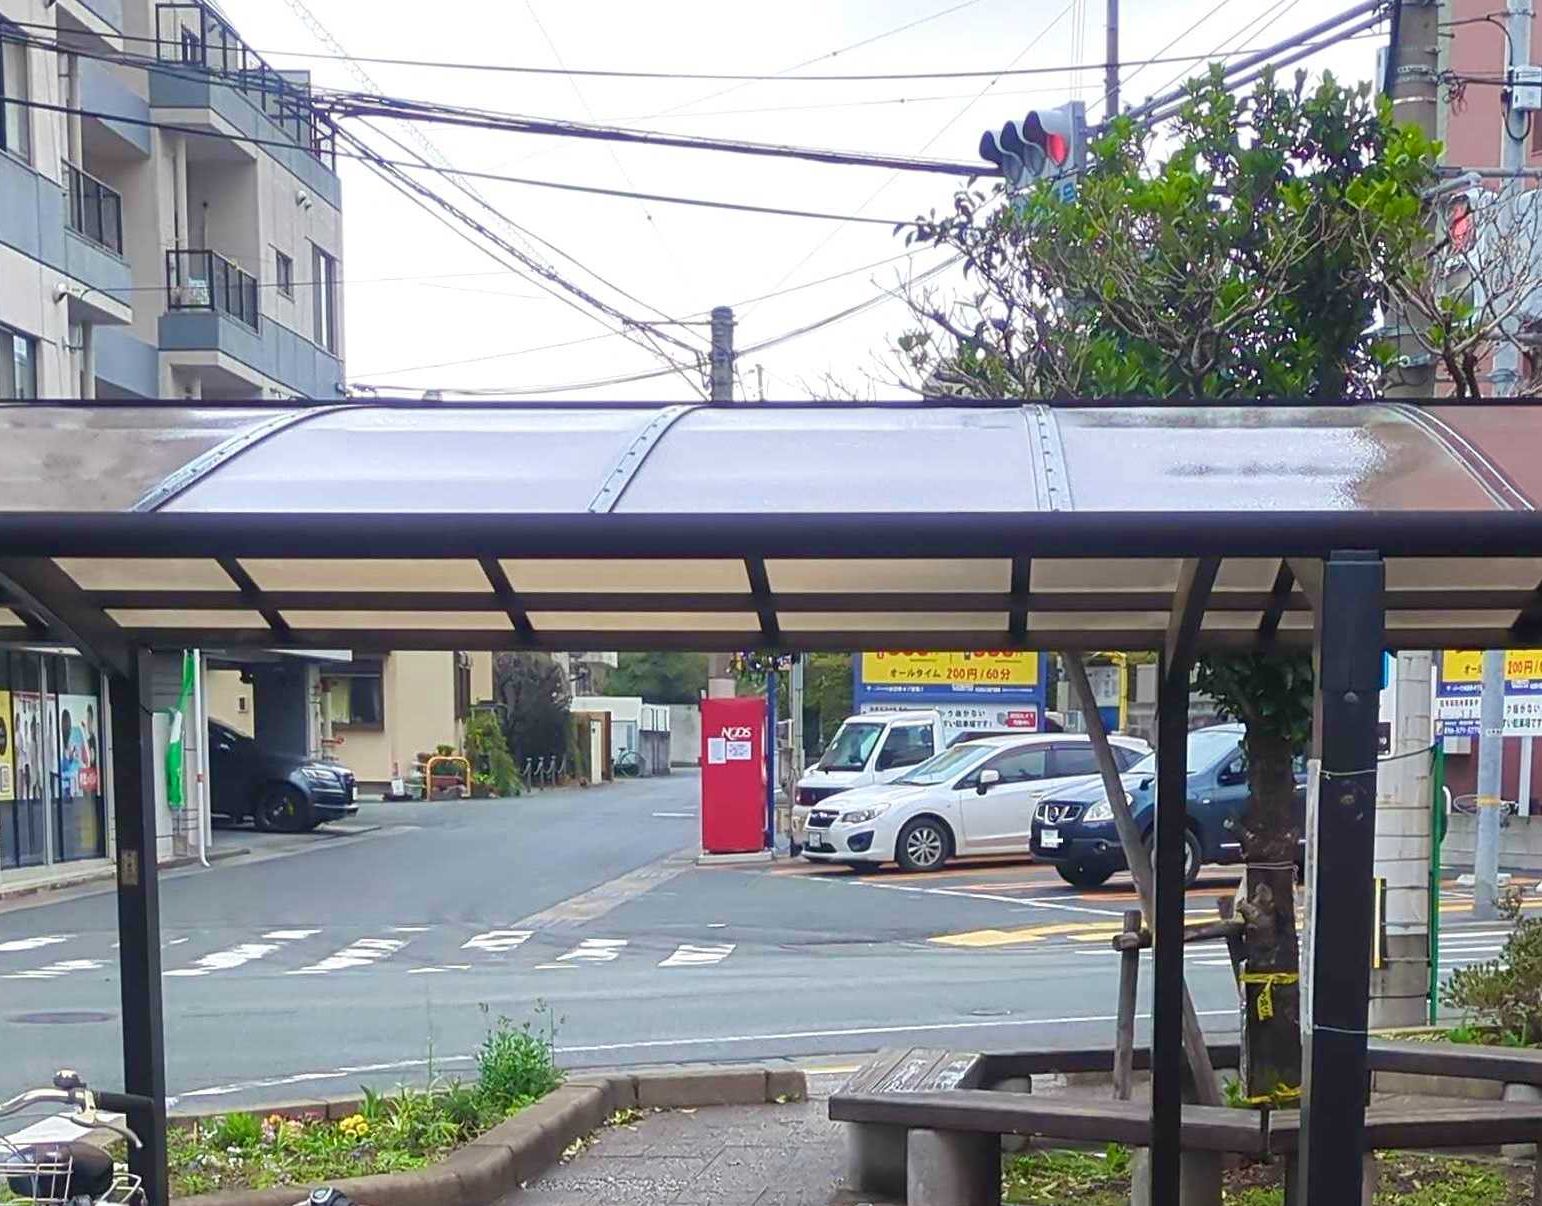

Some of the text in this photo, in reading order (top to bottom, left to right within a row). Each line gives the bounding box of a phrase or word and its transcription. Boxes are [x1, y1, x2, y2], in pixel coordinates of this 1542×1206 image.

[890, 669, 941, 678] オールタイム
